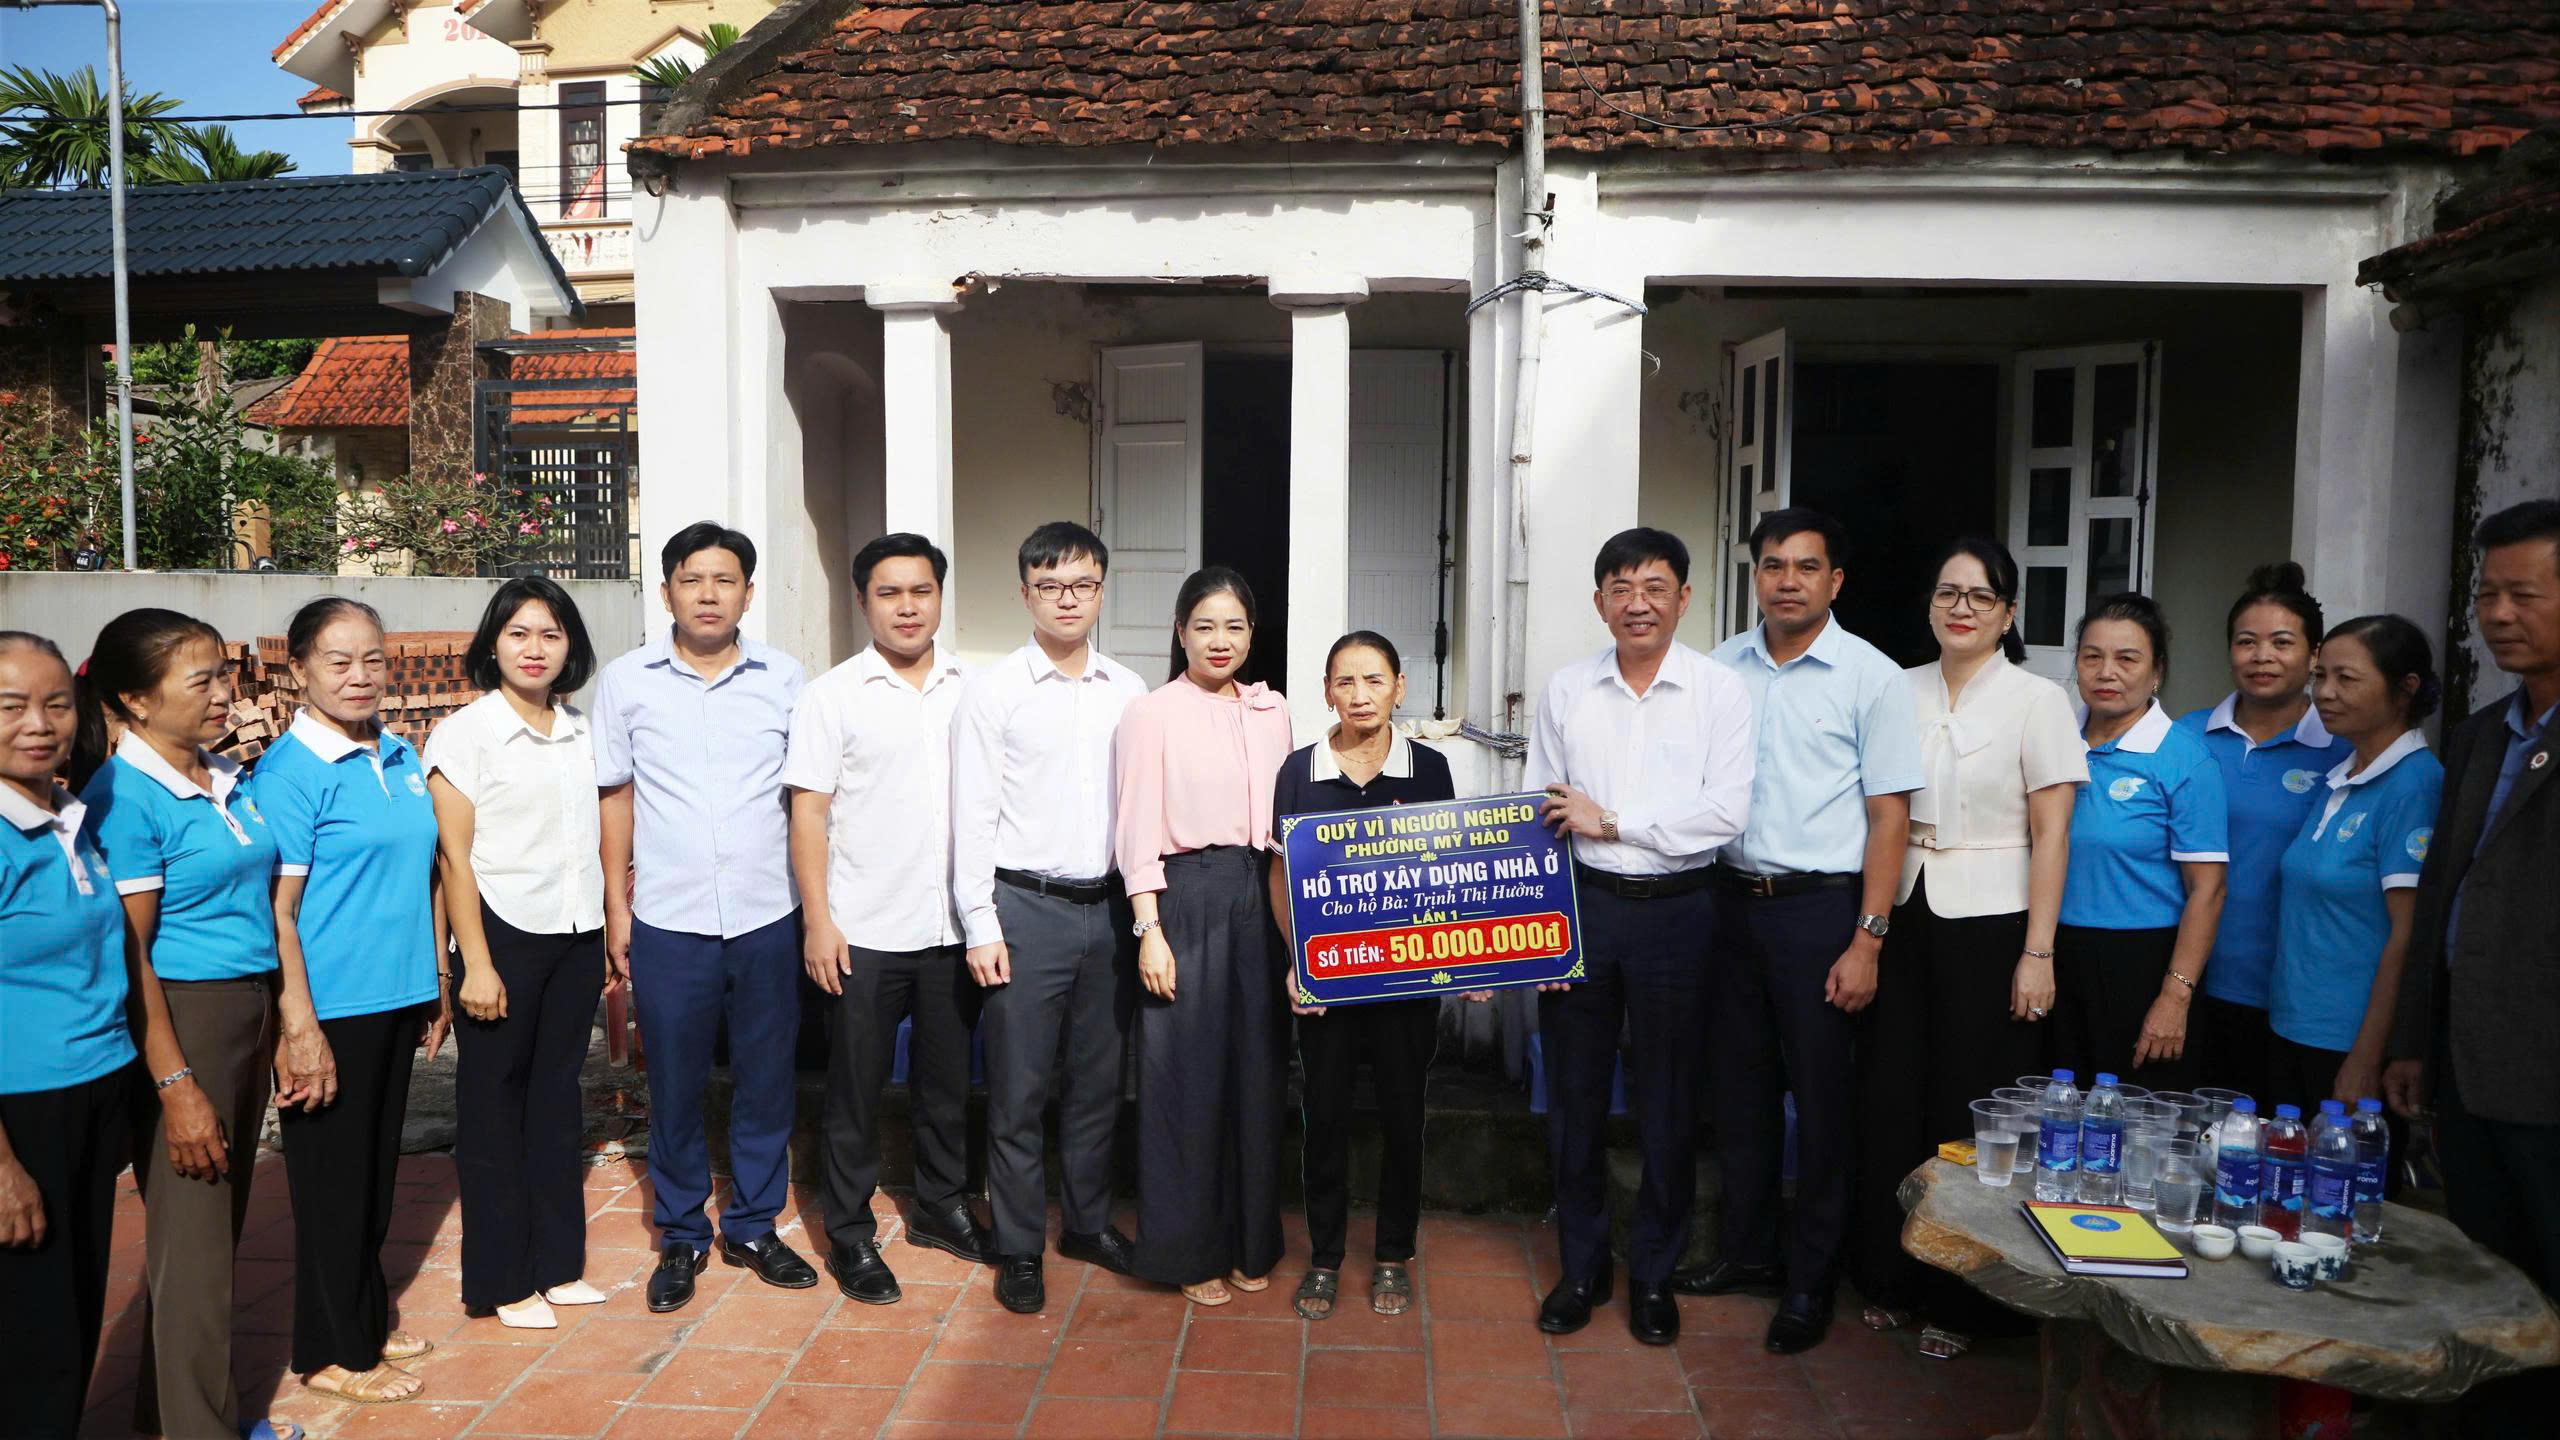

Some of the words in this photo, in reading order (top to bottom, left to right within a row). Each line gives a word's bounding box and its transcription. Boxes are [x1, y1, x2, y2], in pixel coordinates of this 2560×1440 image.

[1316, 818, 1357, 844] QUỸ
[1363, 816, 1385, 838] VÌ
[1391, 809, 1458, 836] NGƯỜI
[1463, 802, 1535, 829] NGHÈO
[1345, 837, 1428, 859] PHƯỜNG
[1433, 830, 1464, 850] MỸ
[1469, 828, 1511, 847] HÀO
[1302, 869, 1332, 899] HỖ
[1336, 869, 1378, 897] TRỢ
[1382, 864, 1423, 892] XÂY
[1428, 861, 1489, 890] DỰNG
[1493, 852, 1540, 881] NHÀ
[1544, 847, 1560, 876] Ở
[1321, 900, 1353, 917] Cho
[1358, 896, 1378, 916] hộ
[1381, 894, 1409, 912] Bà:
[1413, 889, 1457, 910] Trịnh
[1461, 885, 1488, 905] Thị
[1491, 881, 1545, 900] Hưởng
[1412, 908, 1447, 925] LẦN
[1450, 910, 1459, 921] 1
[1317, 944, 1340, 968] SỐ
[1343, 940, 1386, 965] TIỀN:
[1390, 921, 1563, 964] 50.000.000đ
